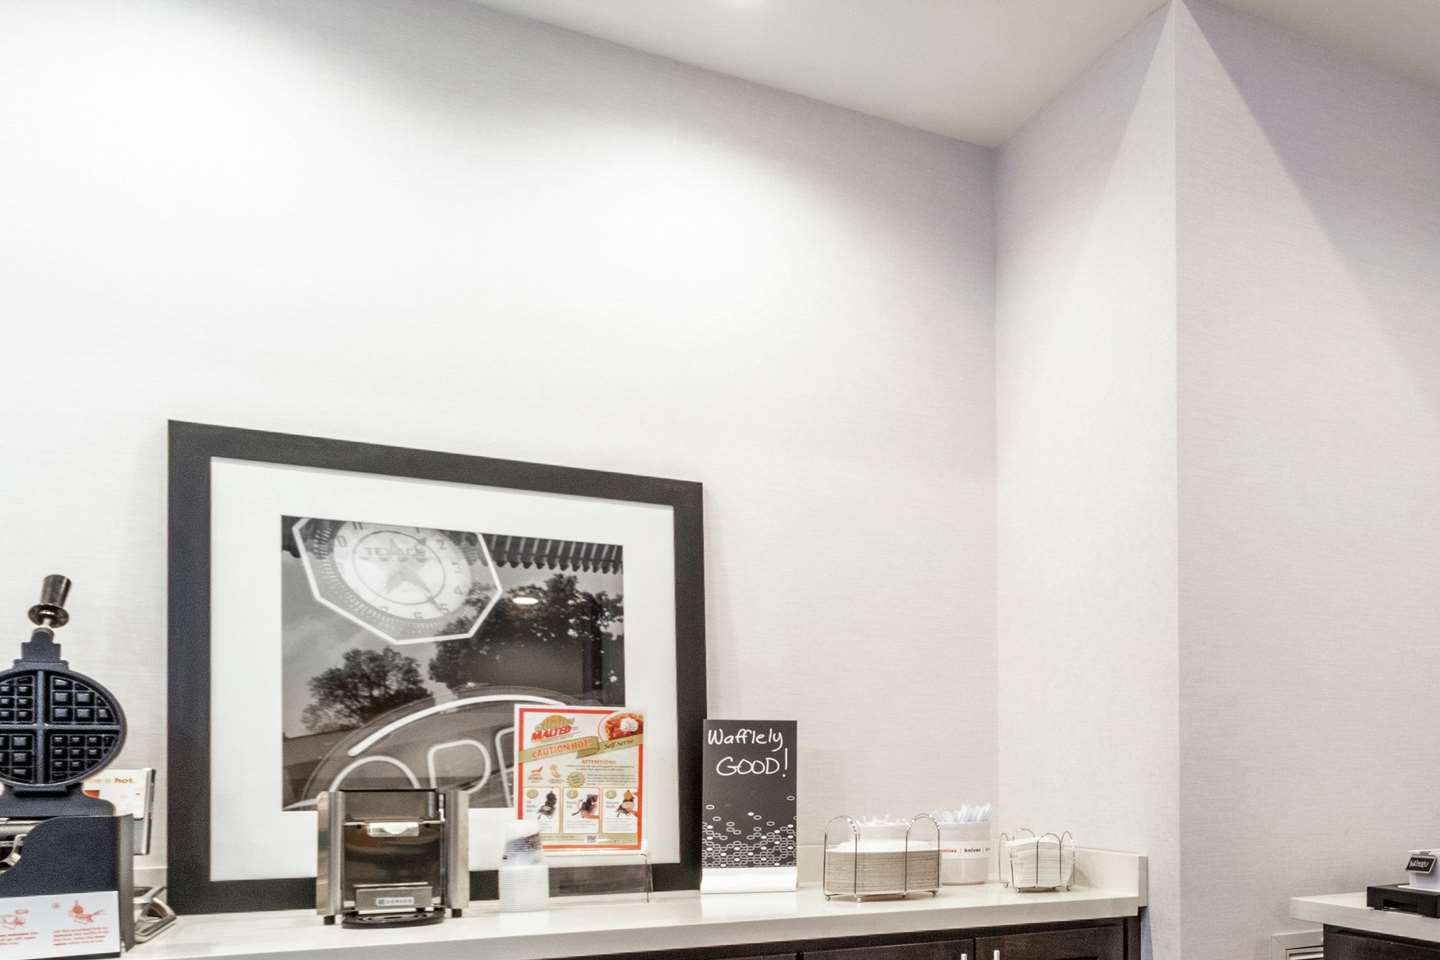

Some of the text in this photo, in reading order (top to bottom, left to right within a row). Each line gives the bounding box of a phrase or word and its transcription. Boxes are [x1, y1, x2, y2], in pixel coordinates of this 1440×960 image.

[531, 725, 572, 741] MALTED
[707, 728, 784, 752] Wafflely
[715, 747, 789, 778] GOOD!
